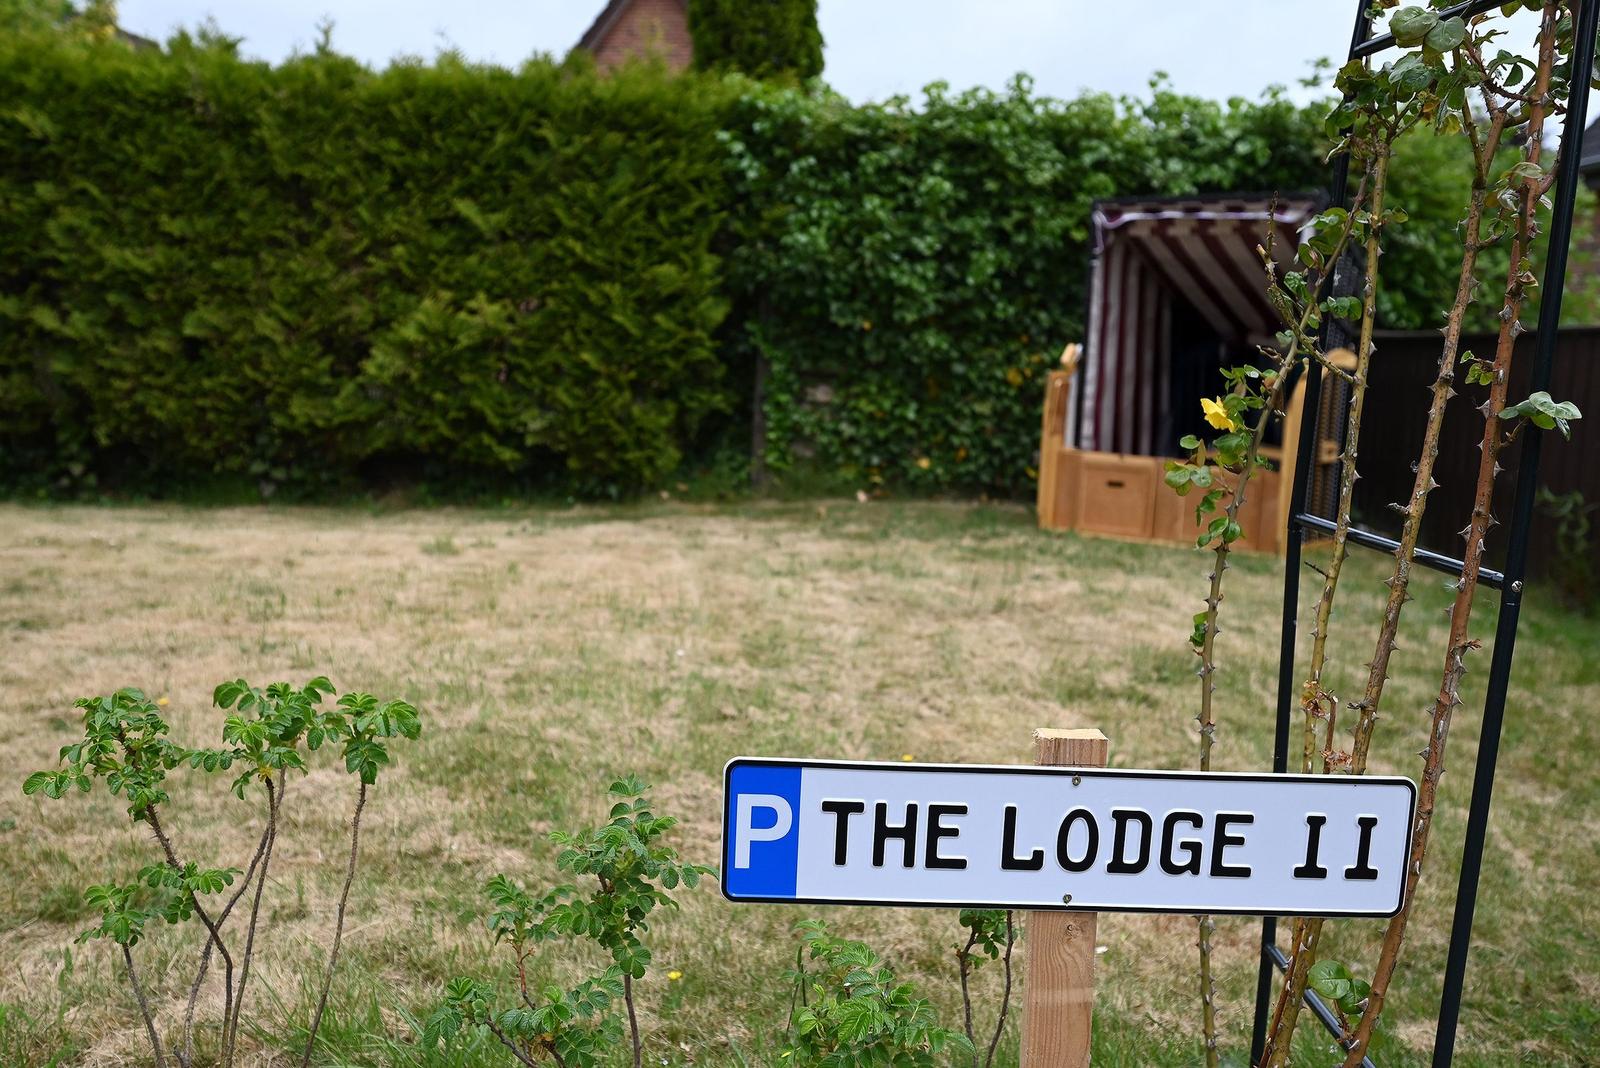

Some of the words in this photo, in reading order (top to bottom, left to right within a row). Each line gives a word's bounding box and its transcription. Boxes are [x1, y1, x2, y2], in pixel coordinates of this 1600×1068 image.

[735, 794, 793, 869] P
[822, 801, 967, 870] THE
[1002, 807, 1254, 878] LODGE
[1294, 816, 1378, 880] II
